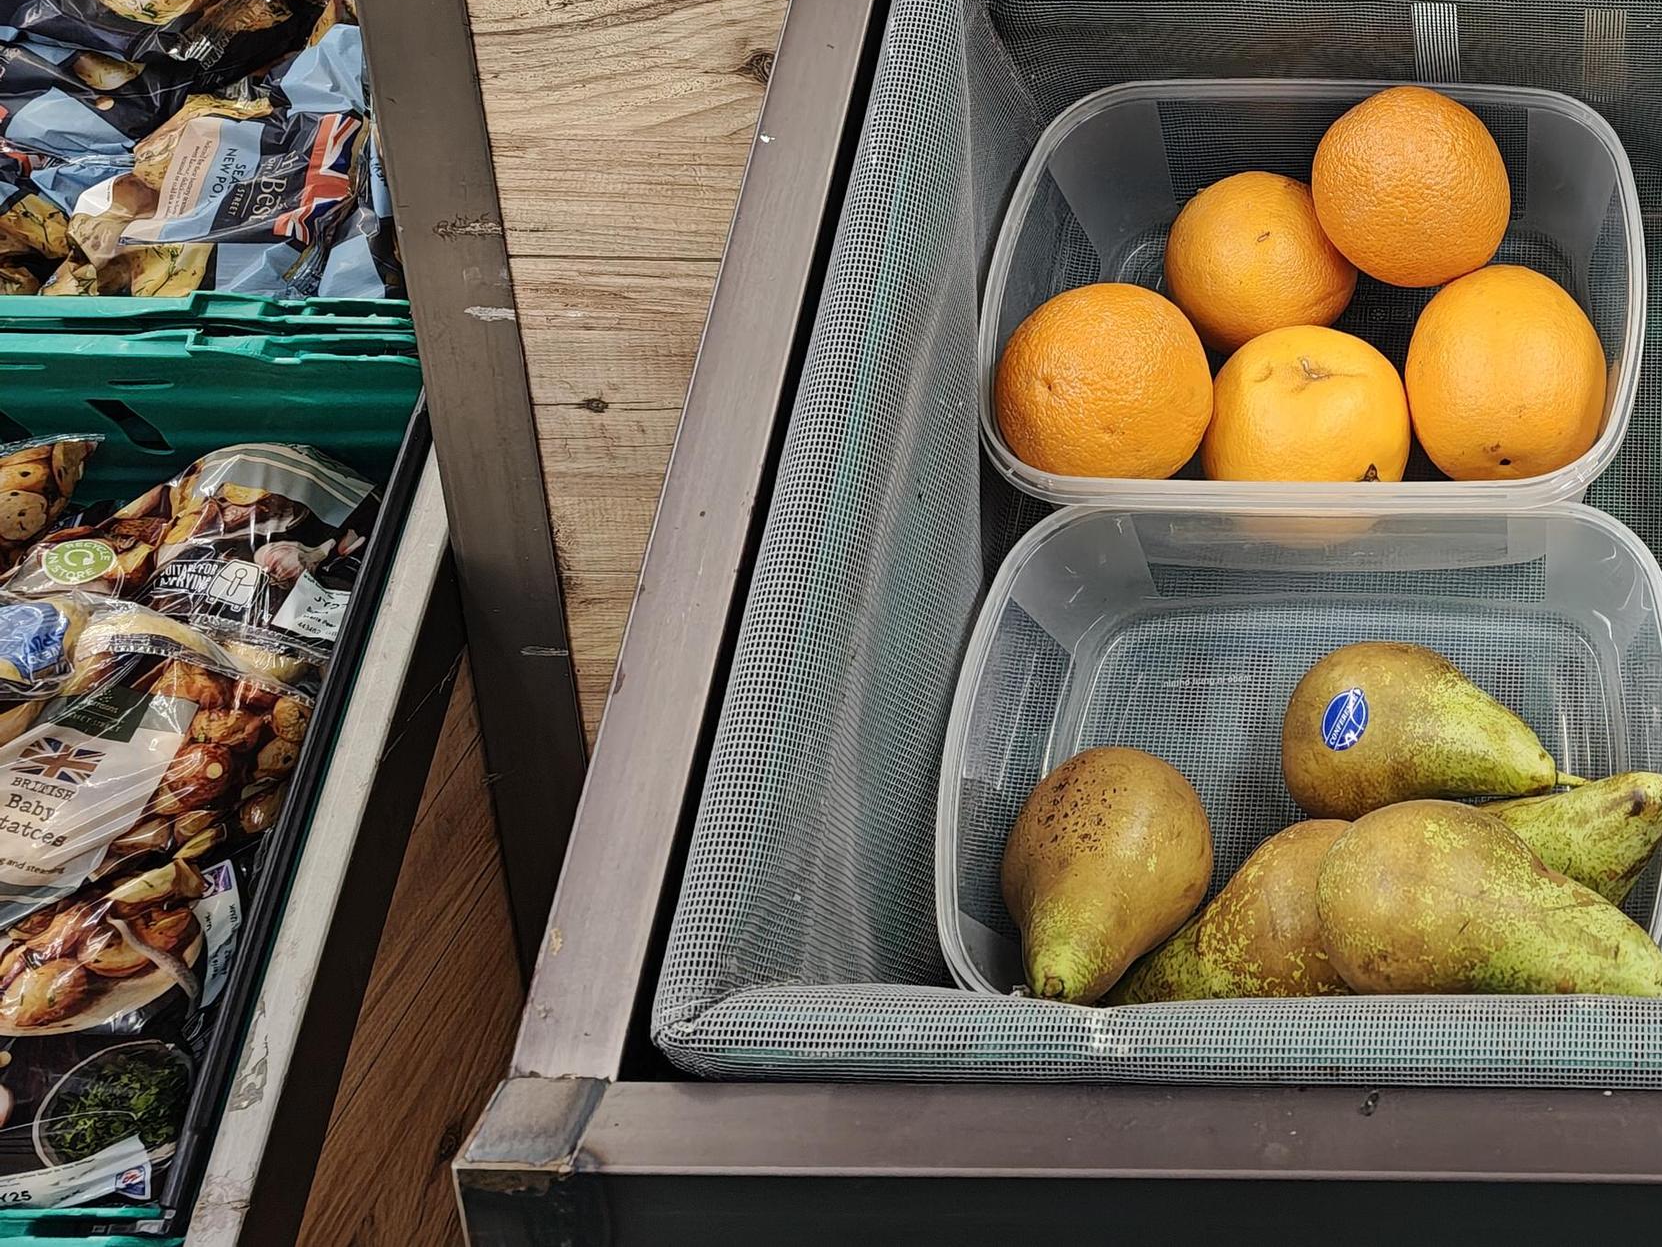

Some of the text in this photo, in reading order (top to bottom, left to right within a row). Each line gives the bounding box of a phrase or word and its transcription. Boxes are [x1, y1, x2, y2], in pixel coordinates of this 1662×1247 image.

[219, 148, 238, 174] NEW
[228, 188, 245, 216] STREET
[250, 177, 288, 220] Best
[47, 552, 96, 580] IN STORE
[65, 542, 111, 562] RECYCLE
[11, 776, 76, 801] BRITISH
[5, 793, 55, 822] Baby
